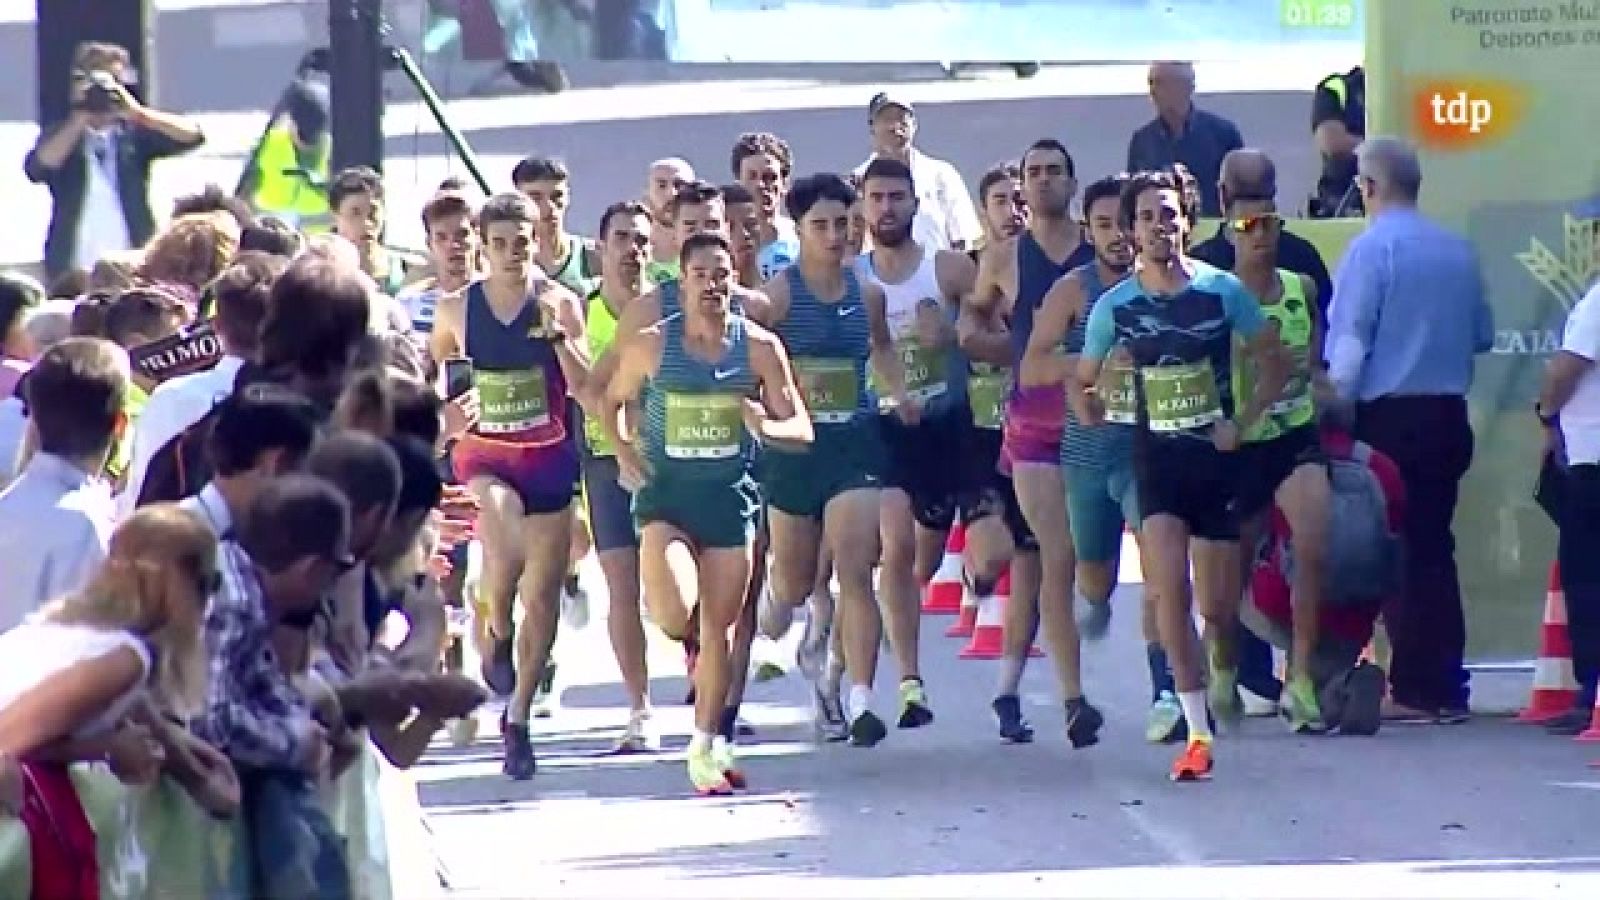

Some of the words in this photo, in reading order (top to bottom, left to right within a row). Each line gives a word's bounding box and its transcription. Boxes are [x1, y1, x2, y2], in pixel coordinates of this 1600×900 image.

[1450, 7, 1553, 24] Patronato
[1479, 29, 1576, 49] Deportes
[1174, 379, 1184, 394] 1
[484, 397, 542, 416] MARIANO
[676, 424, 731, 441] IGNACIO
